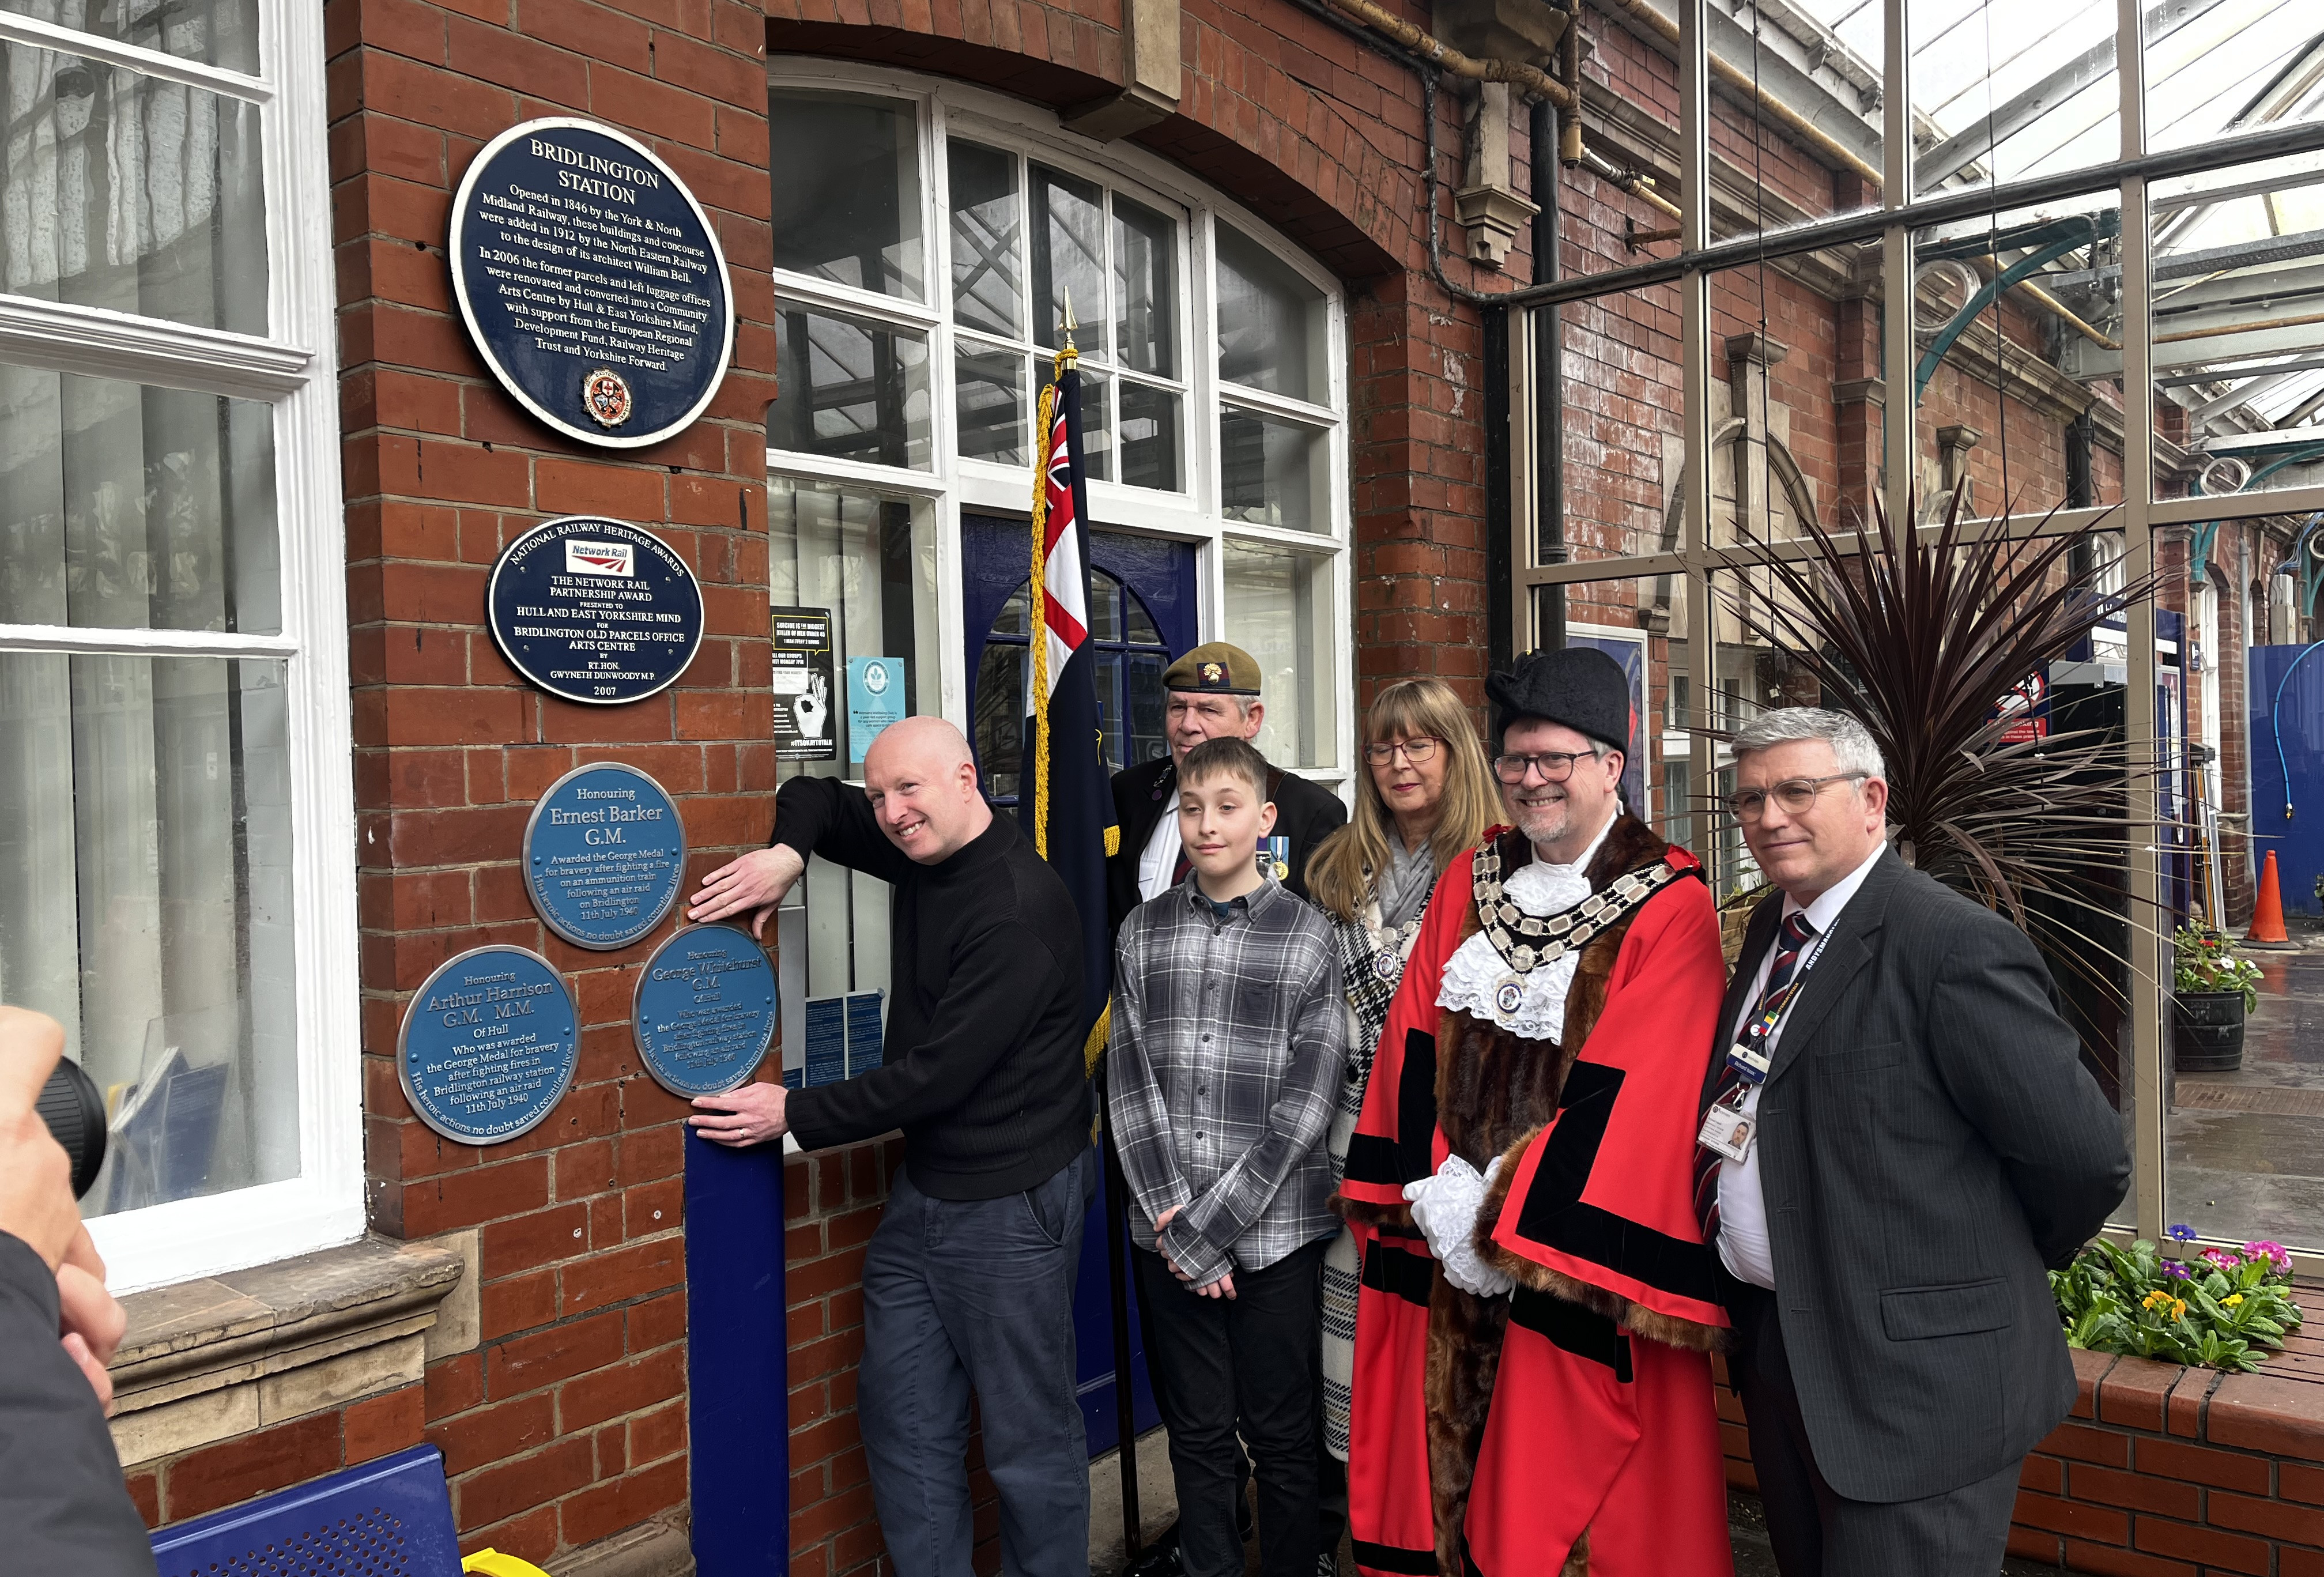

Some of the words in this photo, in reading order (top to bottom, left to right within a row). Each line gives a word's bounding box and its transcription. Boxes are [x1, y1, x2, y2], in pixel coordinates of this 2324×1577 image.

[530, 138, 658, 189] BRIDLINGTON
[559, 170, 635, 205] STATION
[510, 184, 548, 203] Opened
[550, 194, 560, 206] in
[564, 198, 587, 213] 1846
[589, 205, 601, 219] by
[605, 209, 618, 221] the
[620, 212, 642, 227] York
[645, 219, 654, 229] &
[655, 221, 681, 237] North
[482, 193, 525, 213] Midland
[528, 203, 570, 225] Railway,
[572, 216, 597, 231] these
[599, 222, 641, 242] buildings
[644, 236, 659, 246] and
[662, 241, 704, 257] concourse
[479, 210, 504, 224] were
[507, 217, 537, 232] added
[540, 222, 549, 235] in
[553, 226, 575, 240] 1912
[578, 232, 590, 246] by
[593, 237, 608, 248] the
[610, 240, 637, 255] North
[639, 247, 670, 263] Eastern
[672, 255, 707, 274] Railway
[500, 231, 511, 241] to
[513, 233, 530, 246] the
[531, 237, 563, 254] design
[566, 246, 578, 256] of
[579, 248, 590, 259] its
[593, 254, 632, 270] architect
[634, 261, 669, 278] William
[670, 269, 691, 283] Bell.
[479, 246, 491, 259] In
[493, 250, 519, 265] 2006
[522, 256, 537, 269] the
[540, 260, 572, 277] former
[574, 271, 608, 284] parcels
[610, 278, 627, 288] and
[629, 280, 644, 293] left
[646, 284, 680, 301] luggage
[681, 292, 710, 307] offices
[485, 266, 511, 279] were
[513, 273, 562, 290] renovated
[564, 284, 581, 294] and
[584, 288, 628, 304] converted
[631, 296, 648, 308] into
[656, 301, 707, 322] Community
[499, 284, 521, 297] Arts
[523, 288, 556, 304] Centre
[558, 295, 571, 308] by
[574, 298, 593, 312] Hull
[596, 303, 605, 314] &
[606, 305, 627, 319] East
[628, 310, 671, 327] Yorkshire
[672, 319, 697, 334] Mind,
[504, 302, 529, 314] with
[531, 308, 567, 322] support
[569, 313, 592, 327] from
[594, 318, 609, 330] the
[610, 321, 652, 339] European
[654, 329, 692, 346] Regional
[515, 318, 578, 339] Development
[580, 330, 608, 346] Fund,
[609, 335, 646, 354] Railway
[647, 343, 684, 361] Heritage
[535, 337, 561, 352] Trust
[564, 345, 580, 355] and
[582, 346, 626, 363] Yorkshire
[628, 354, 667, 371] Forward.
[510, 530, 556, 565] NATIONAL
[557, 523, 601, 536] RAILWAY
[603, 524, 651, 549] HERITAGE
[651, 545, 684, 578] AWARDS
[572, 545, 610, 556] Network
[610, 548, 628, 558] Rail
[549, 587, 616, 599] PARTNERSHIP
[618, 591, 652, 601] AWARD
[551, 576, 573, 585] THE
[575, 577, 624, 588] NETWORK
[627, 580, 650, 590] RAIL
[571, 609, 597, 619] EAST
[598, 610, 654, 621] YORKSHIRE
[655, 613, 681, 622] MIND
[513, 627, 584, 638] BRIDLINGTON
[586, 629, 607, 639] OLD
[609, 631, 650, 640] PARCELS
[652, 632, 685, 642] OFFICE
[568, 640, 595, 650] ARTS
[597, 641, 635, 651] CENTRE
[550, 670, 592, 678] GWYNETH
[594, 671, 640, 680] DUNWOODY
[641, 672, 655, 680] M.P.
[594, 686, 616, 695] 2007
[576, 788, 635, 801] Honouring
[549, 808, 605, 824] Ernest
[608, 804, 662, 821] Barker
[585, 828, 626, 845] G.M.
[550, 853, 591, 864] Awarded
[593, 852, 606, 861] the
[608, 851, 637, 862] George
[638, 848, 663, 858] Medal
[1805, 918, 1840, 971] ANDYSMAN
[463, 971, 516, 986] Honouring
[652, 965, 696, 982] George
[692, 976, 720, 991] G.M.
[427, 992, 482, 1011] Arthur
[485, 982, 553, 1002] Harrison
[443, 1008, 482, 1027] G.M.
[493, 999, 534, 1019] M.M.
[452, 1044, 475, 1055] Who
[477, 1042, 495, 1051] was
[497, 1032, 535, 1047] awarded
[473, 1027, 486, 1038] Of
[487, 1024, 508, 1036] Hull
[427, 1062, 442, 1073] the
[443, 1057, 478, 1069] George
[480, 1049, 508, 1063] Medal
[510, 1048, 523, 1057] for
[526, 1043, 559, 1054] bravery
[448, 1070, 470, 1081] after
[472, 1063, 508, 1077] fighting
[510, 1059, 530, 1069] fires
[433, 1080, 488, 1096] Bridlington
[489, 1072, 523, 1085] railway
[525, 1066, 555, 1078] station
[450, 1090, 495, 1105] following
[510, 1083, 522, 1093] air
[523, 1078, 541, 1090] raid
